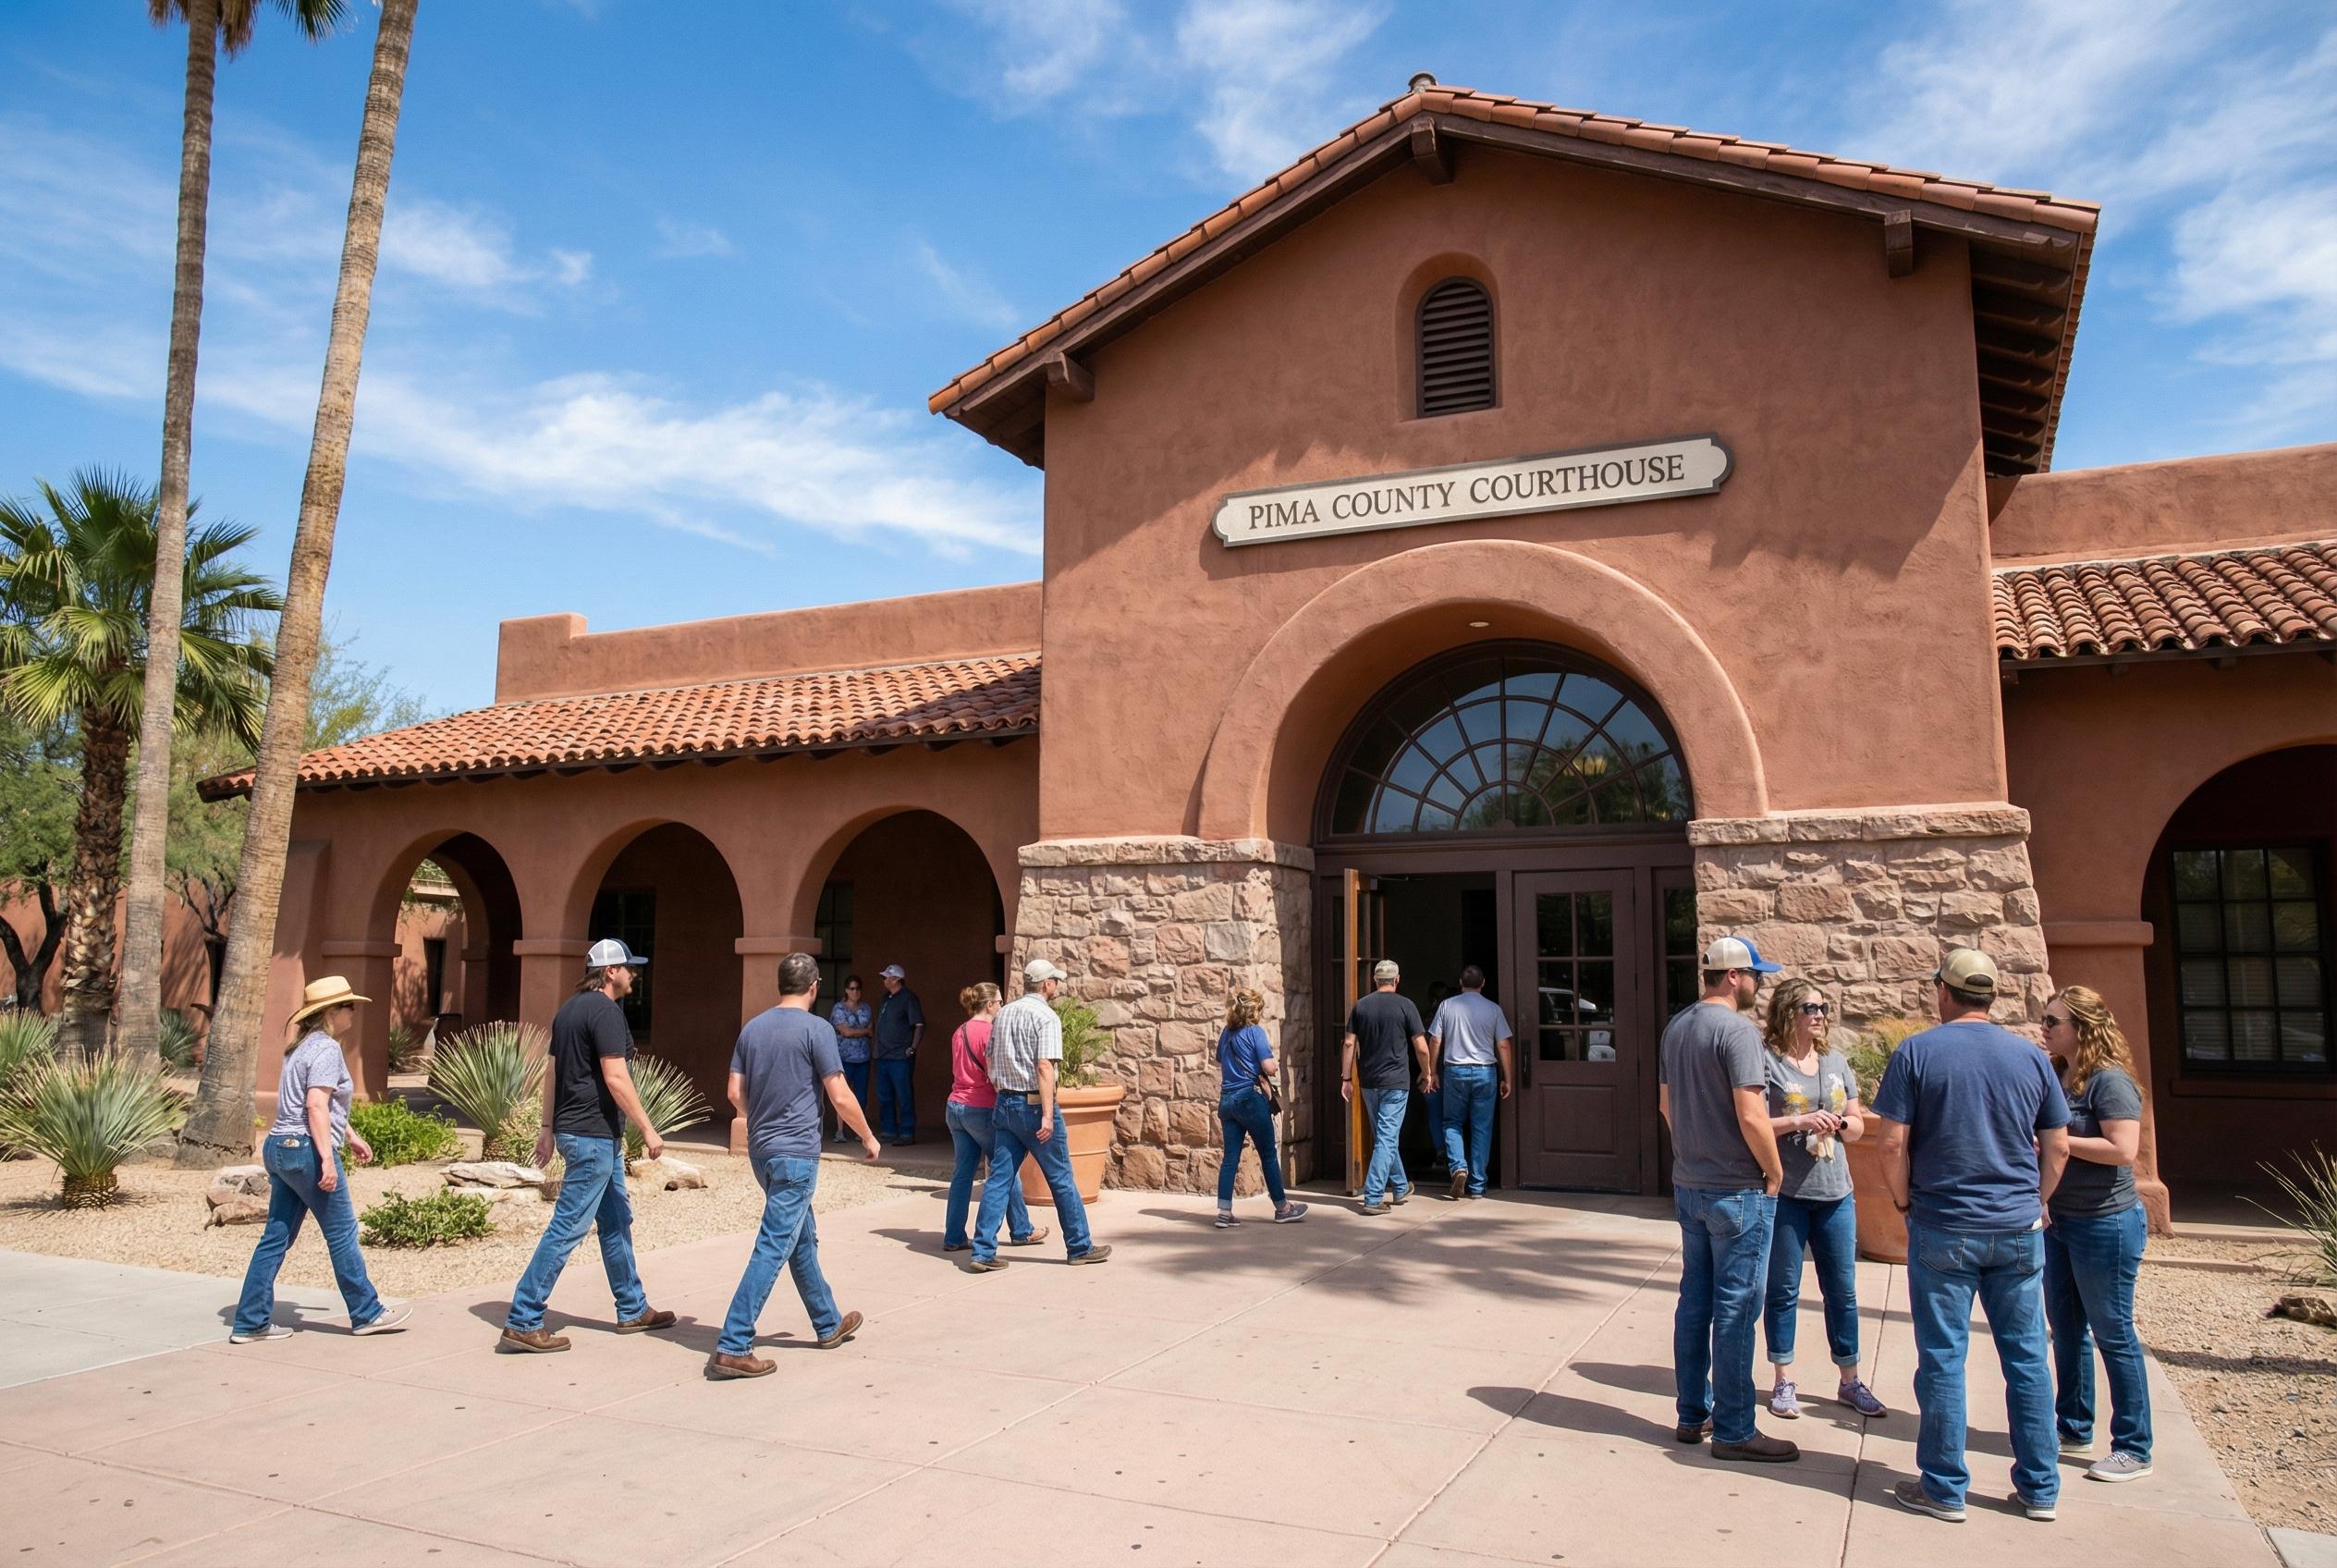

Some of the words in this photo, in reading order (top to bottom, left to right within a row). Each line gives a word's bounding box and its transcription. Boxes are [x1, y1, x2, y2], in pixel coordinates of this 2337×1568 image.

[1249, 499, 1321, 530] PIMA
[1332, 482, 1456, 520] COUNTY
[1469, 454, 1685, 504] COURTHOUSE
